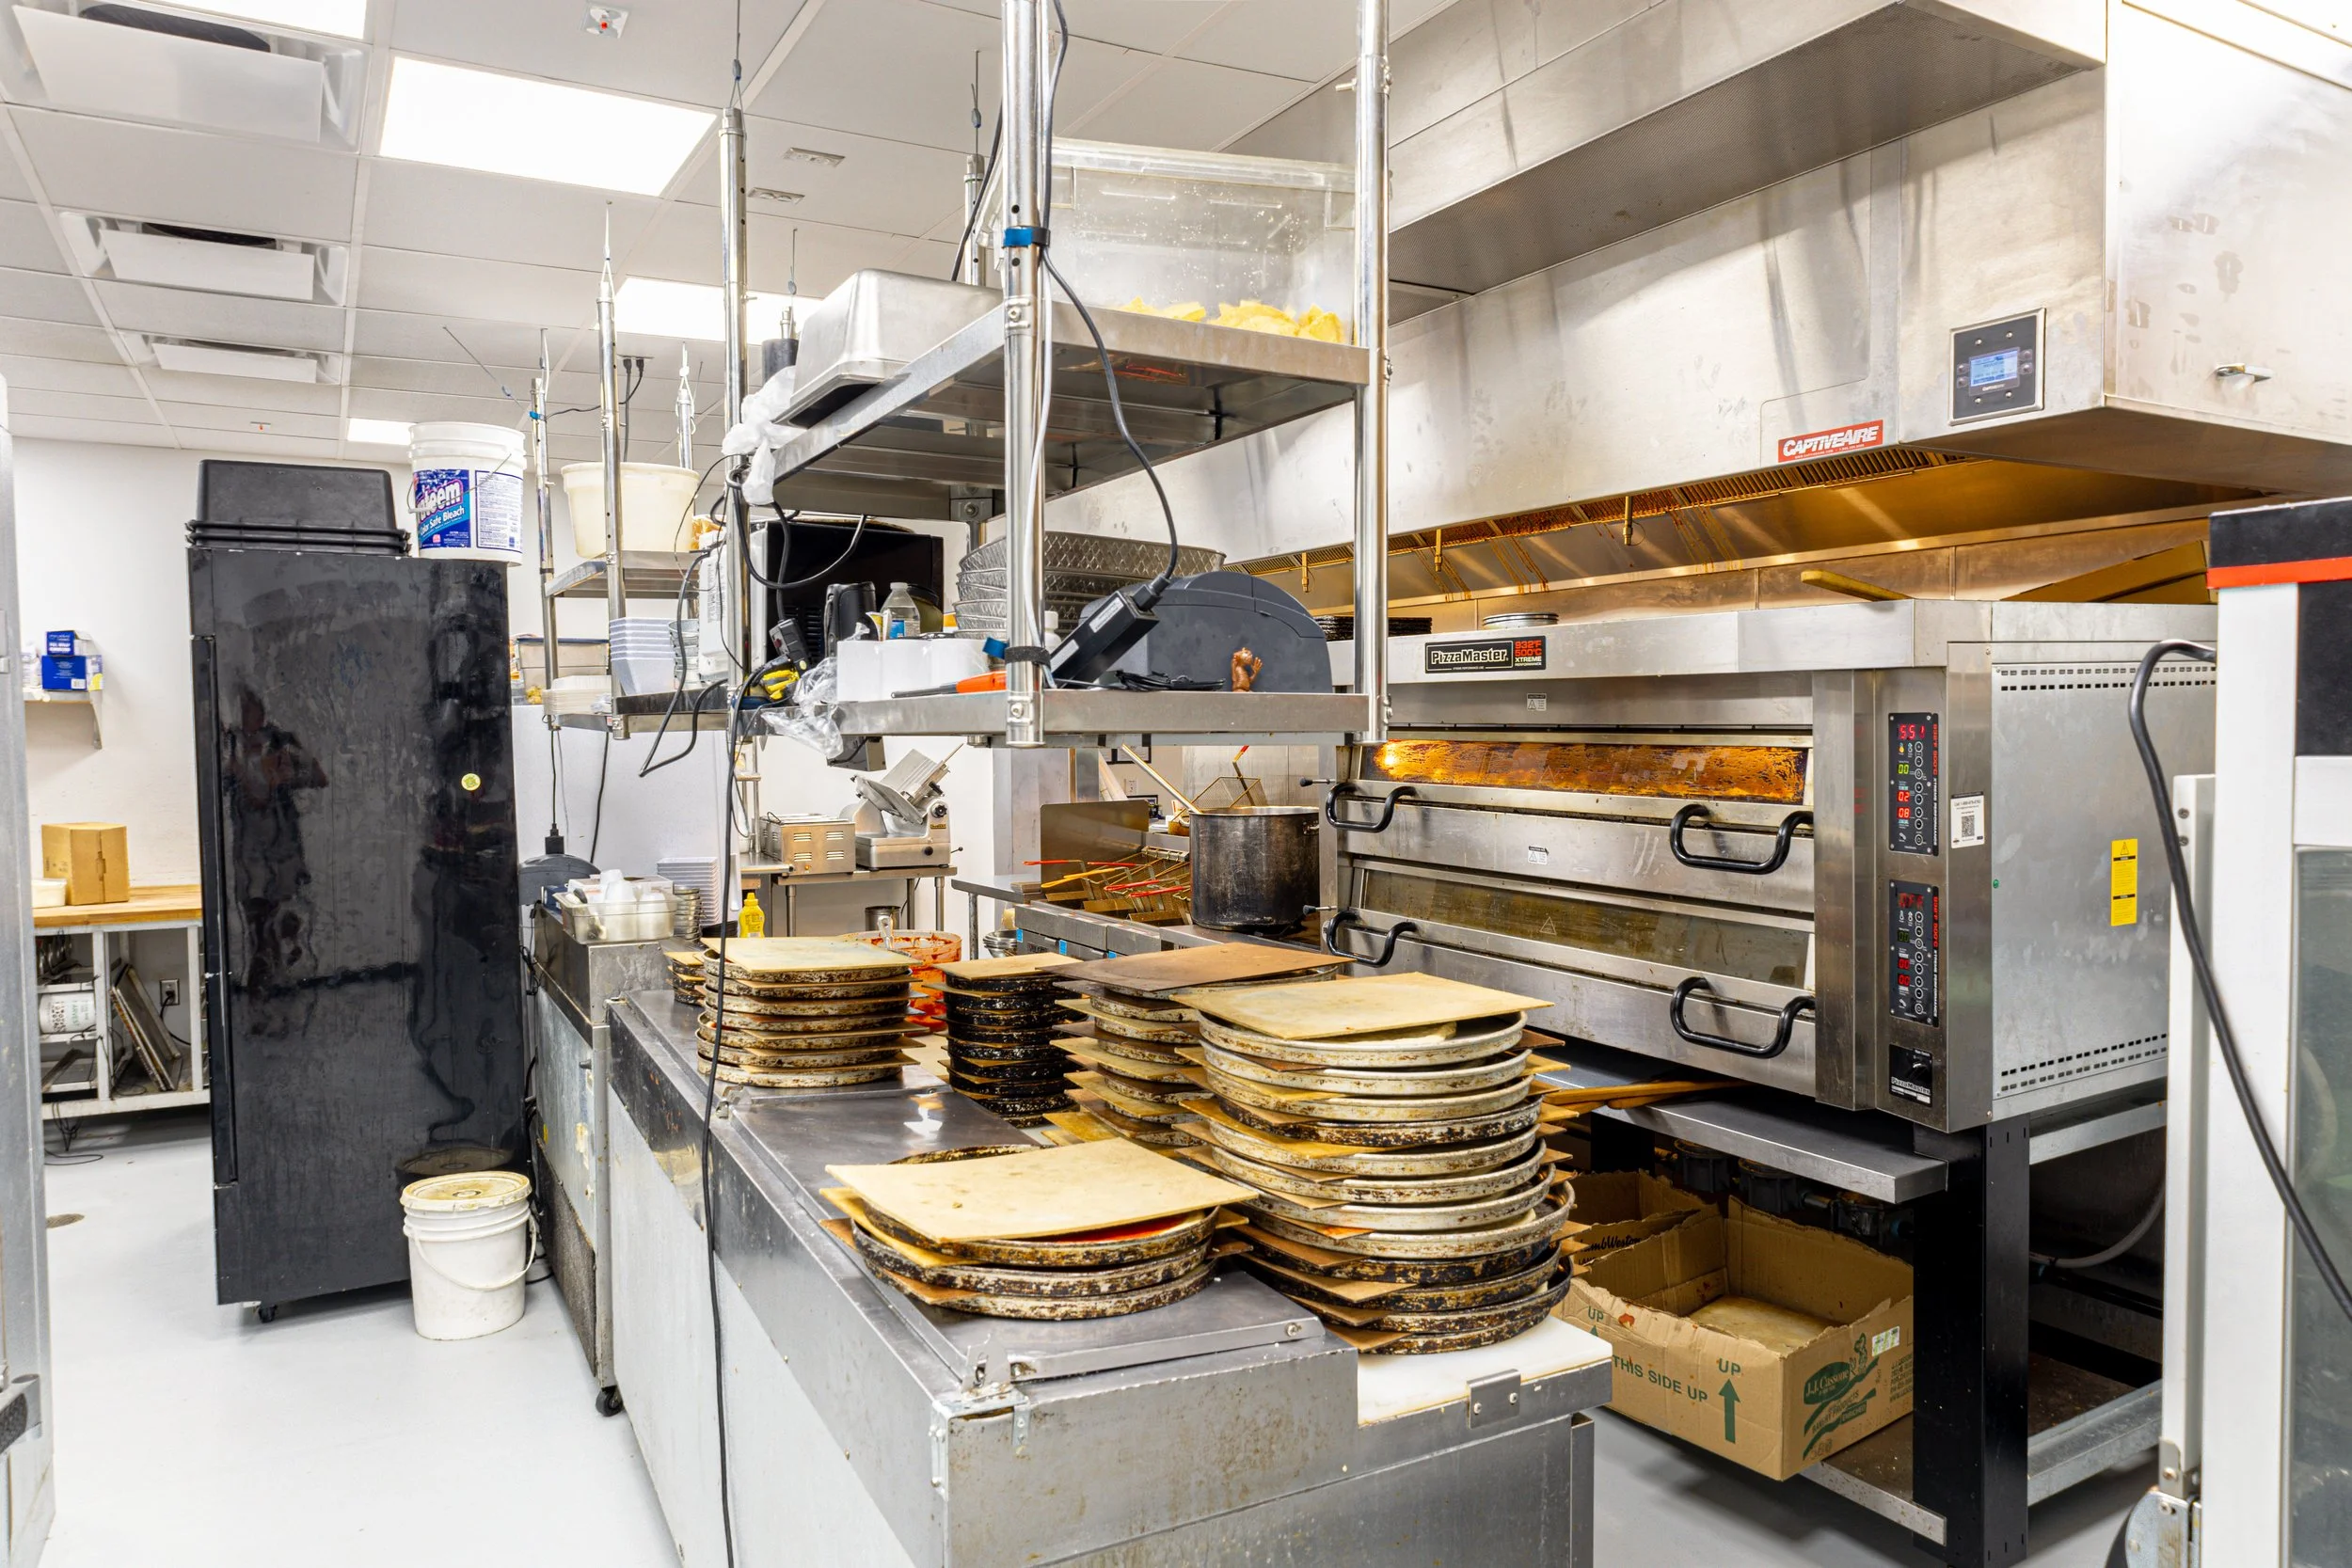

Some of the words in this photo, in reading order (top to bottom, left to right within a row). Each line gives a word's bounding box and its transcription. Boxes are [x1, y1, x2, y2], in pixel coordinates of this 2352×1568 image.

[1783, 426, 1880, 456] CAPTIVEAIRE
[429, 515, 442, 529] Safe
[442, 505, 465, 521] Bleach
[1431, 647, 1507, 665] PizzaMaster
[1898, 764, 1910, 775] 00
[1898, 791, 1910, 802] 02
[1898, 807, 1910, 818] 08
[1588, 1306, 1604, 1323] UP
[1718, 1357, 1741, 1376] UP
[1613, 1354, 1644, 1378] THIS
[1648, 1370, 1682, 1395] SIDE
[1688, 1385, 1708, 1402] UP
